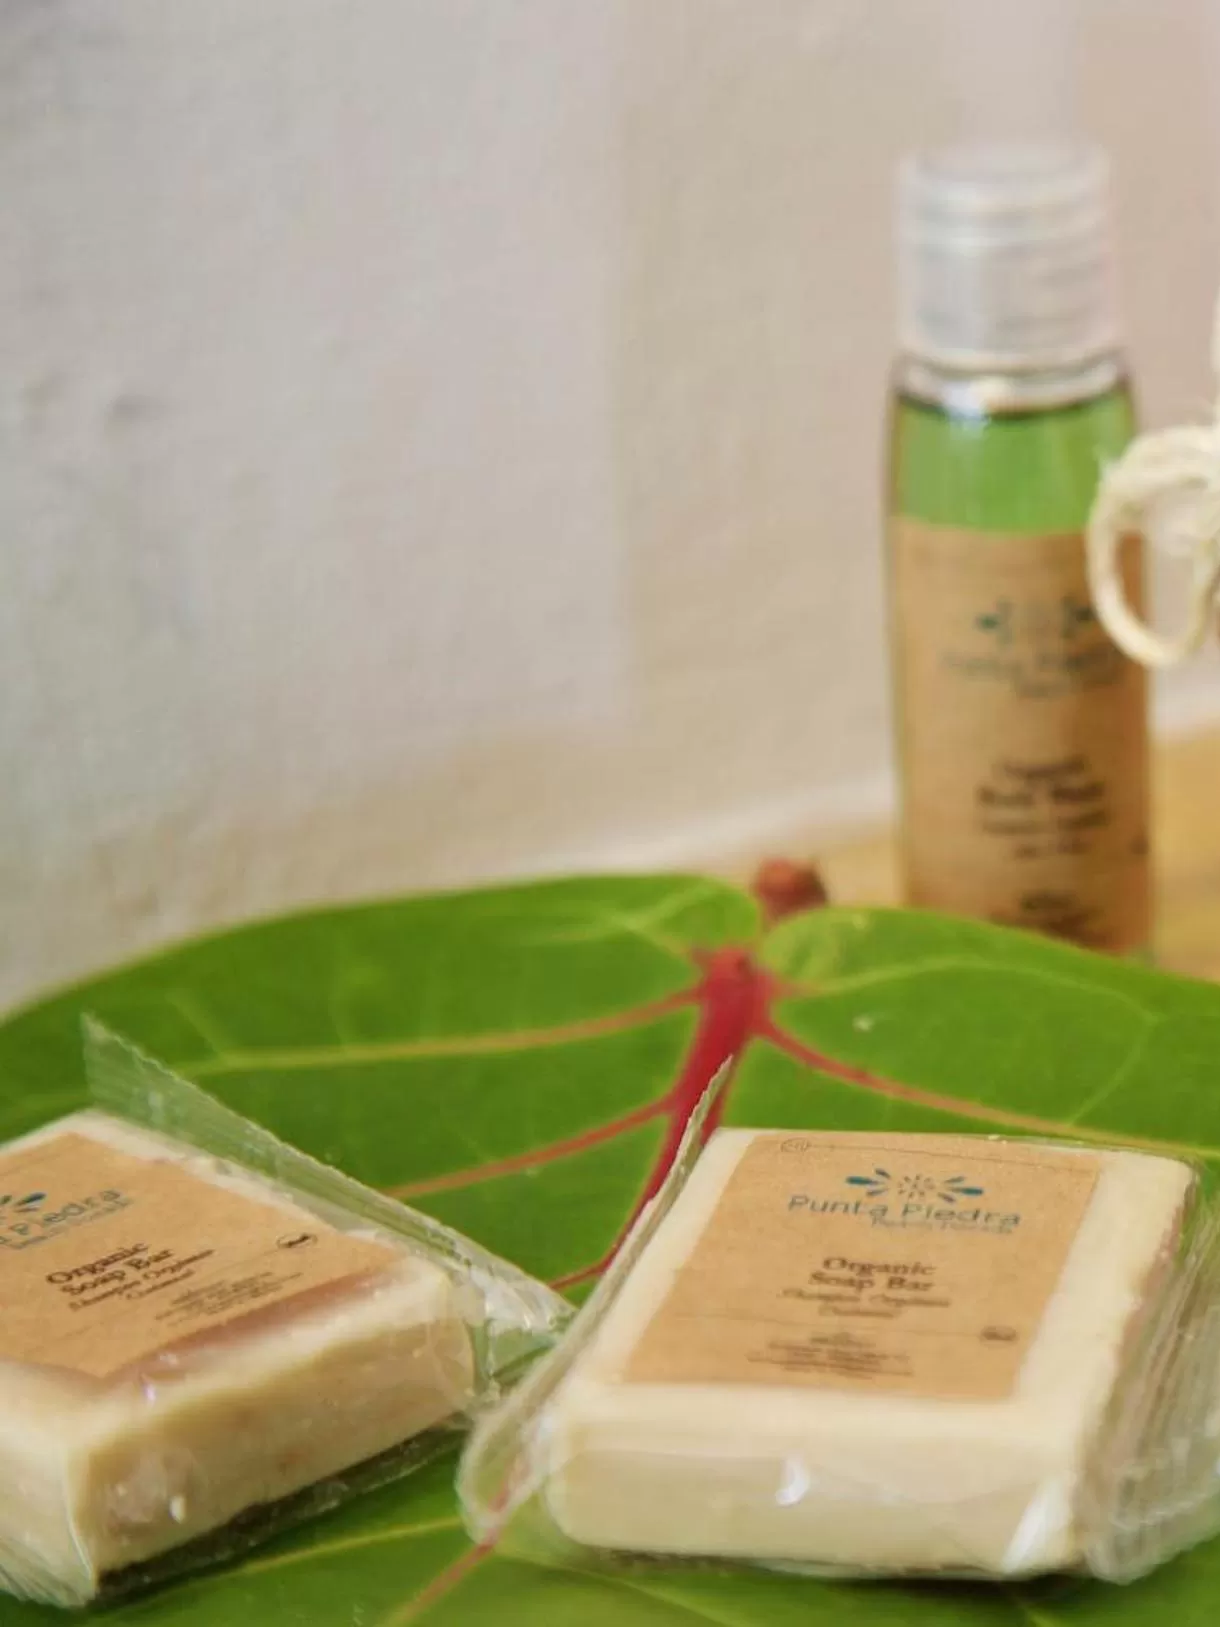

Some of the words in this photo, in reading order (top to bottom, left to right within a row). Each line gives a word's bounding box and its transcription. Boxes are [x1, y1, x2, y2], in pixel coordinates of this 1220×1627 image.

[788, 1195, 889, 1218] Punta
[903, 1203, 1021, 1226] Piedra
[46, 1243, 149, 1284] Organic
[823, 1256, 936, 1277] Organic
[60, 1270, 126, 1295] Soap
[808, 1271, 875, 1293] Soap
[887, 1275, 935, 1291] Bar
